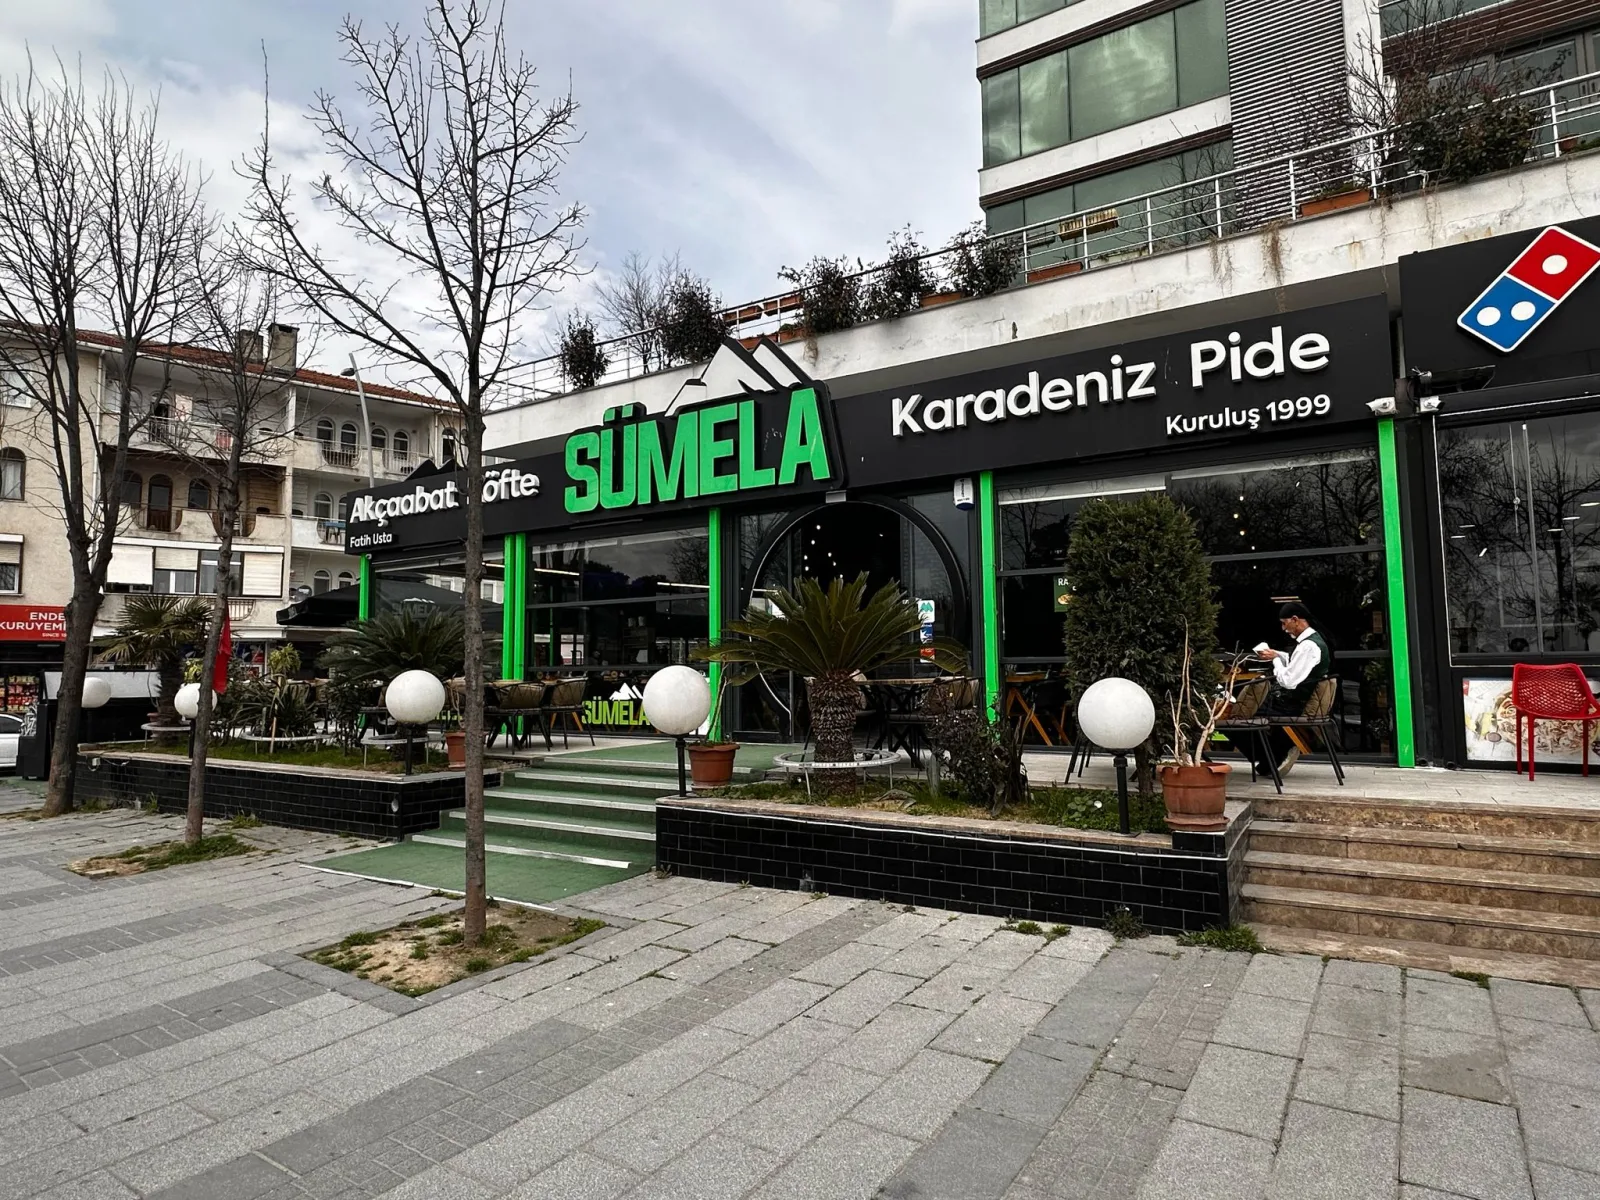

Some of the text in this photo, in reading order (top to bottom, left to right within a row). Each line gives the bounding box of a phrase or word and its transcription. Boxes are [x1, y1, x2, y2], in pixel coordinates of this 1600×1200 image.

[891, 326, 1331, 437] Karadeniz Pide
[1166, 394, 1331, 435] Kuruluş 1999
[564, 387, 831, 514] SÜMELA
[349, 468, 540, 527] Akçaabat öfte
[350, 532, 393, 548] Fatih Usta
